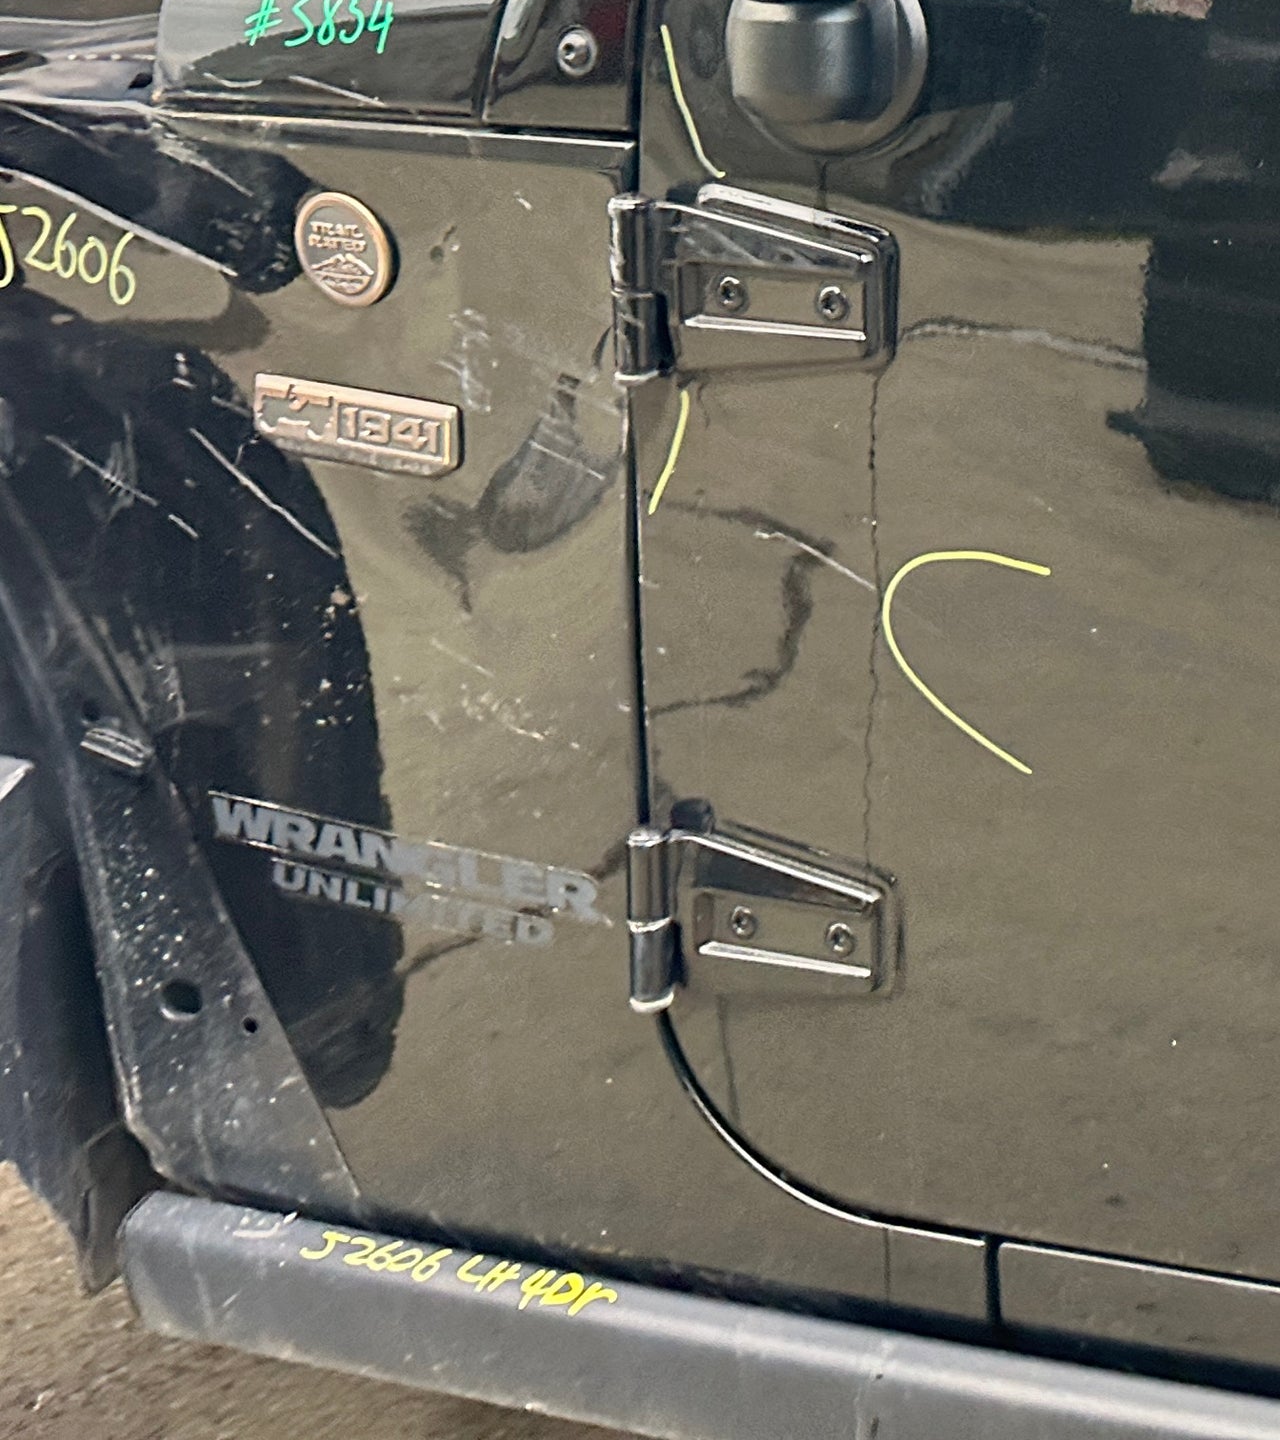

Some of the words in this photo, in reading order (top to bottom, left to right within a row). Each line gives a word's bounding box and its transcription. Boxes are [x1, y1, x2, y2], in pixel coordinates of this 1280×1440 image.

[0, 203, 137, 306] J2606
[340, 405, 441, 455] 1941
[211, 794, 606, 926] WRANGLER
[299, 1229, 453, 1283] J2606
[456, 1253, 522, 1294] LH
